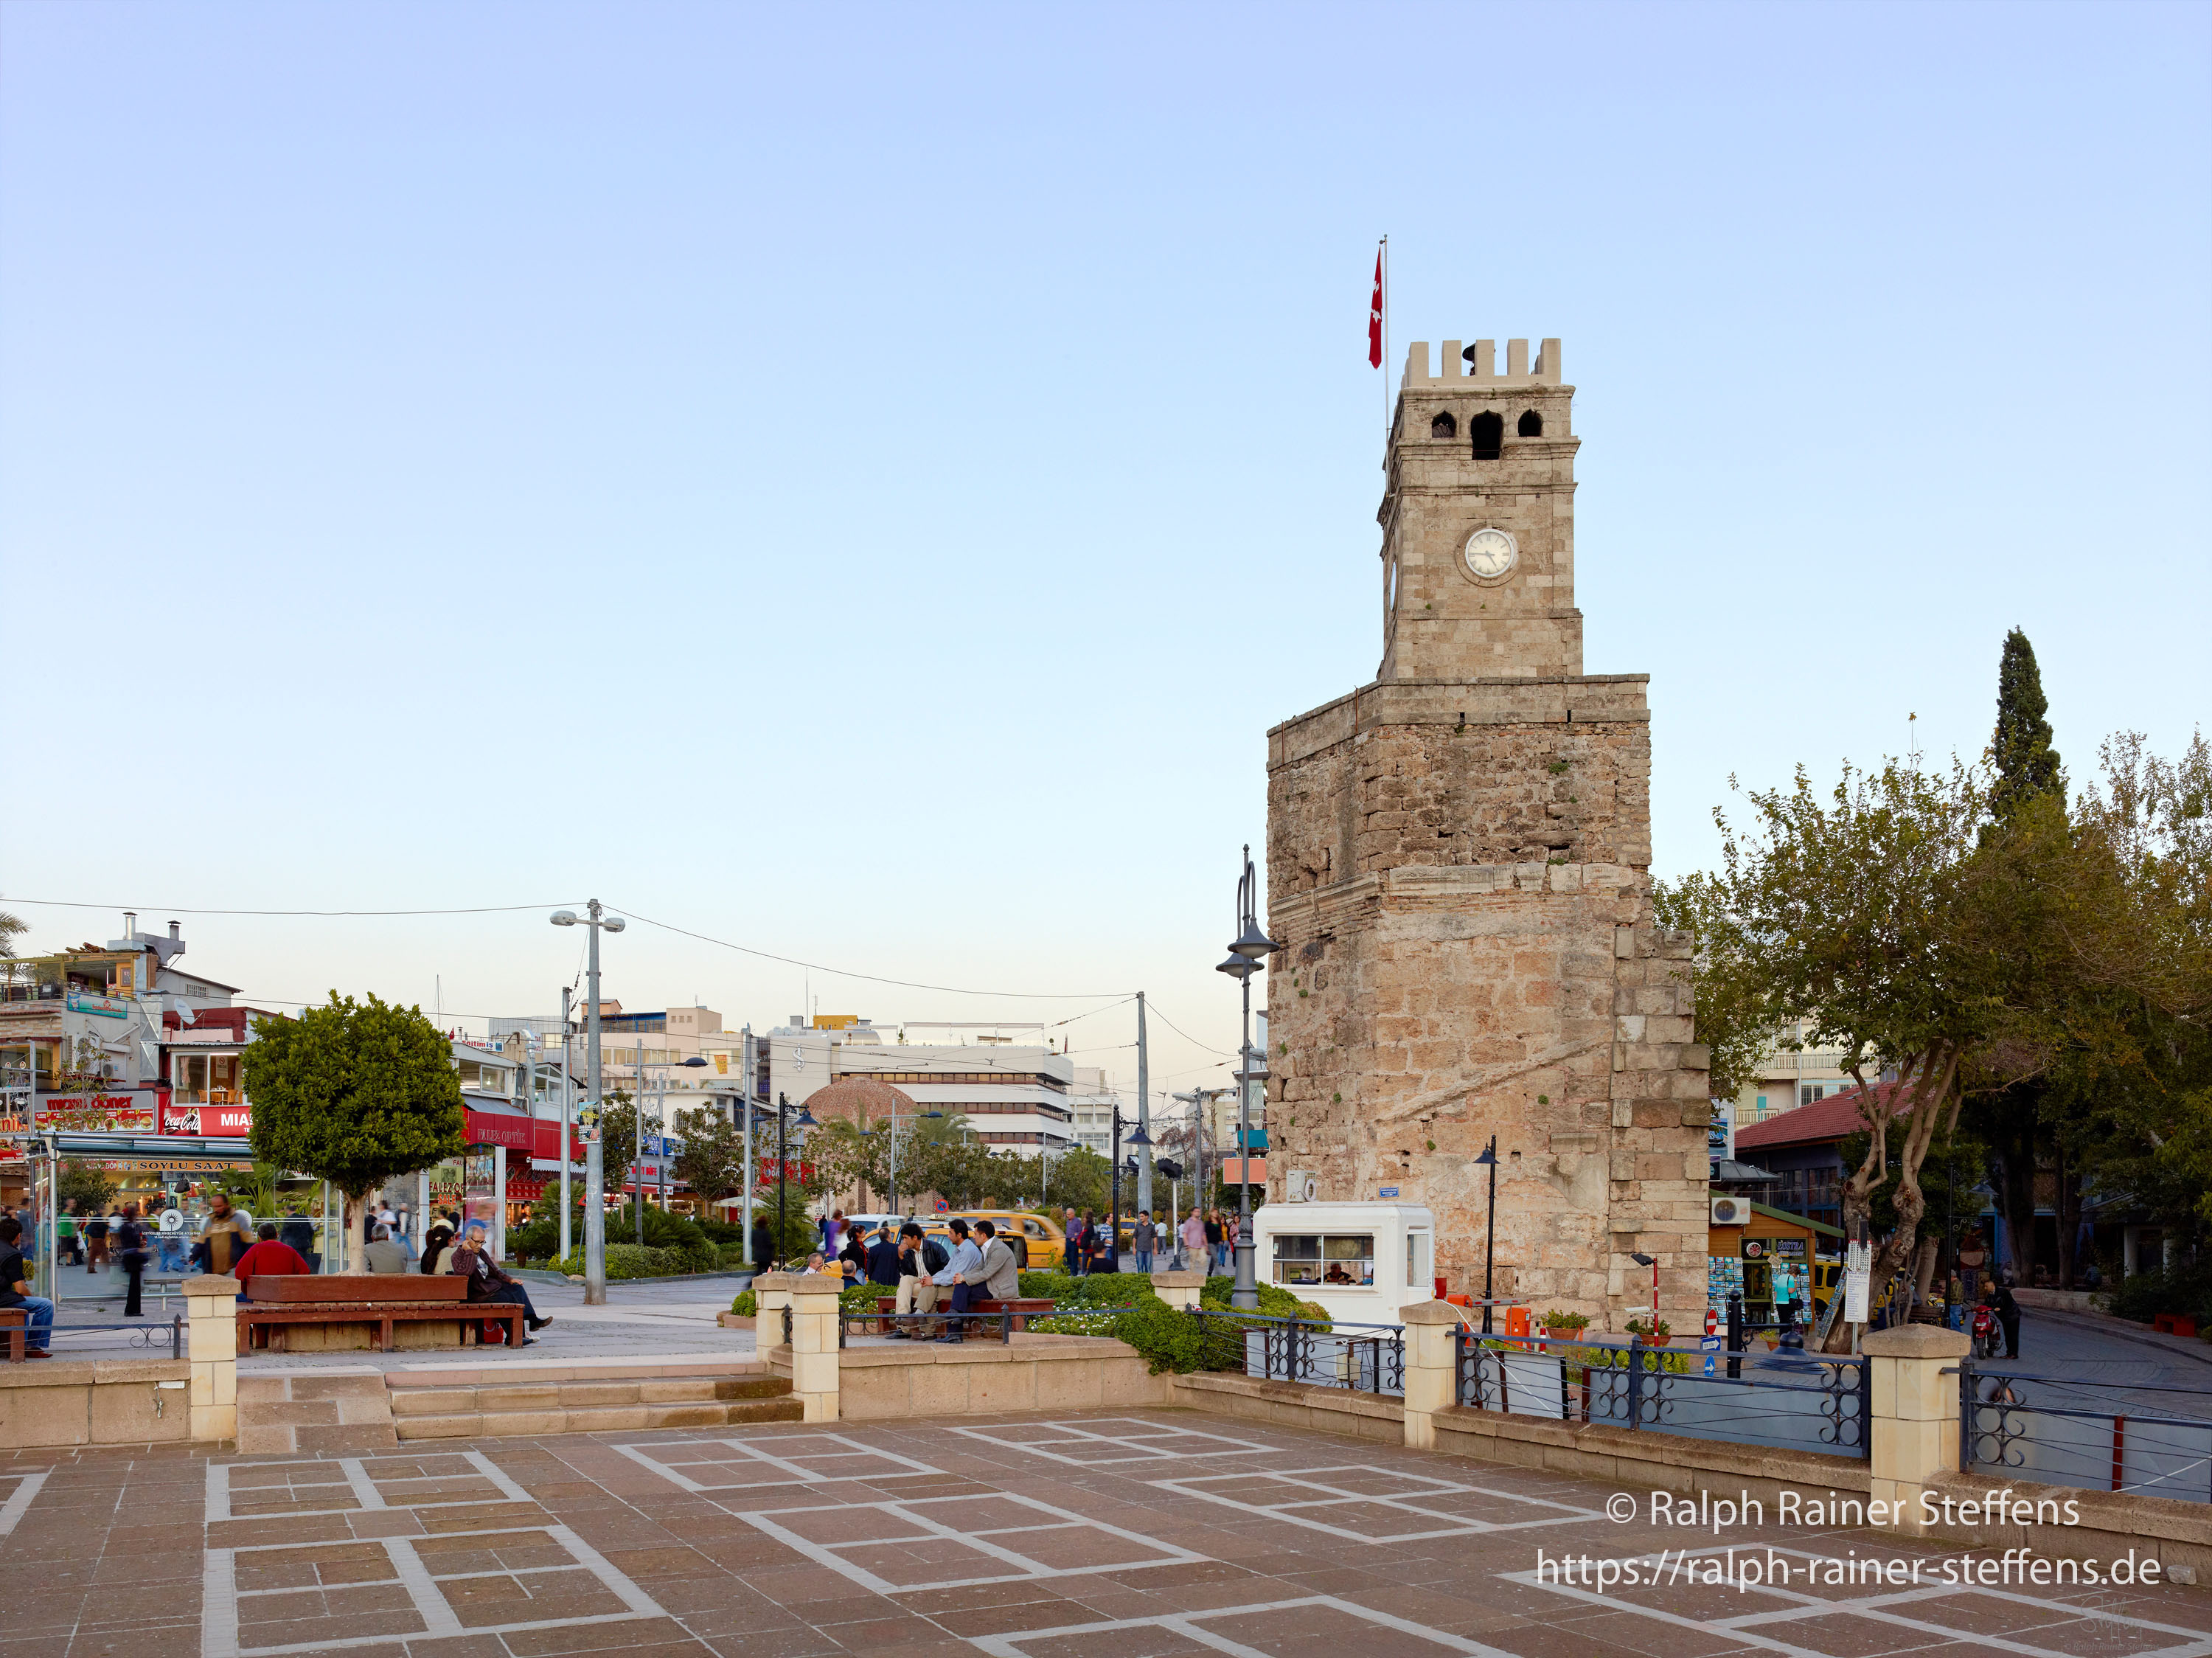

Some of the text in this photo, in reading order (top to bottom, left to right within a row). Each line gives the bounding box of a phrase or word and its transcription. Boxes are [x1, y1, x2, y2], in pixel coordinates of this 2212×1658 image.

[478, 1128, 501, 1142] FALEZ
[139, 1162, 188, 1170] SOYLU
[194, 1162, 234, 1170] SAAT
[429, 1182, 452, 1193] FALEZ
[437, 1193, 456, 1205] SALE
